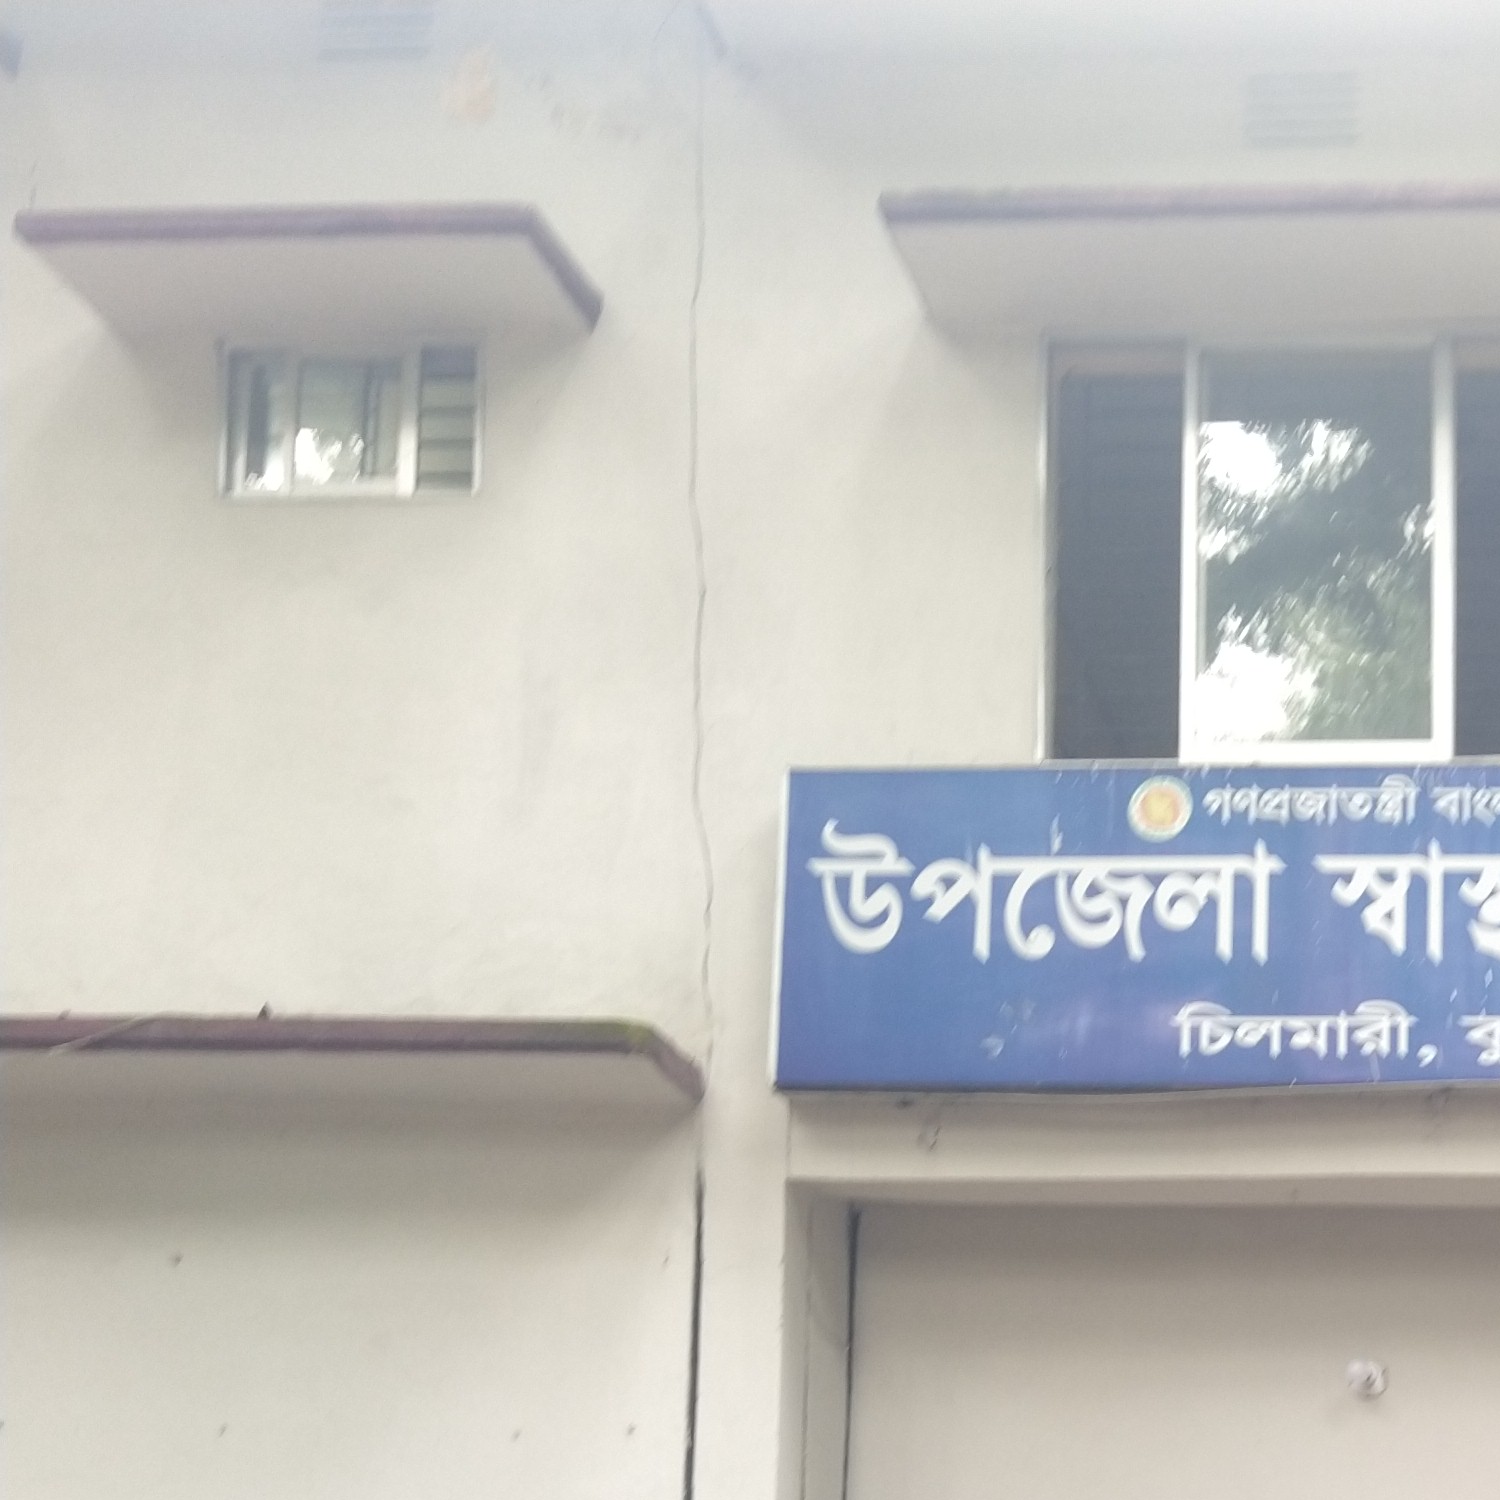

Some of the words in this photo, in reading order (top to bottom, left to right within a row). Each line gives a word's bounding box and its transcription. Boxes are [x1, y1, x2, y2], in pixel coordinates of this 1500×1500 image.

[1202, 774, 1419, 827] গণপ্রজাতন্ত্রী
[805, 818, 1286, 965] উপজেলা
[1171, 1000, 1437, 1067] চিলমারী,
